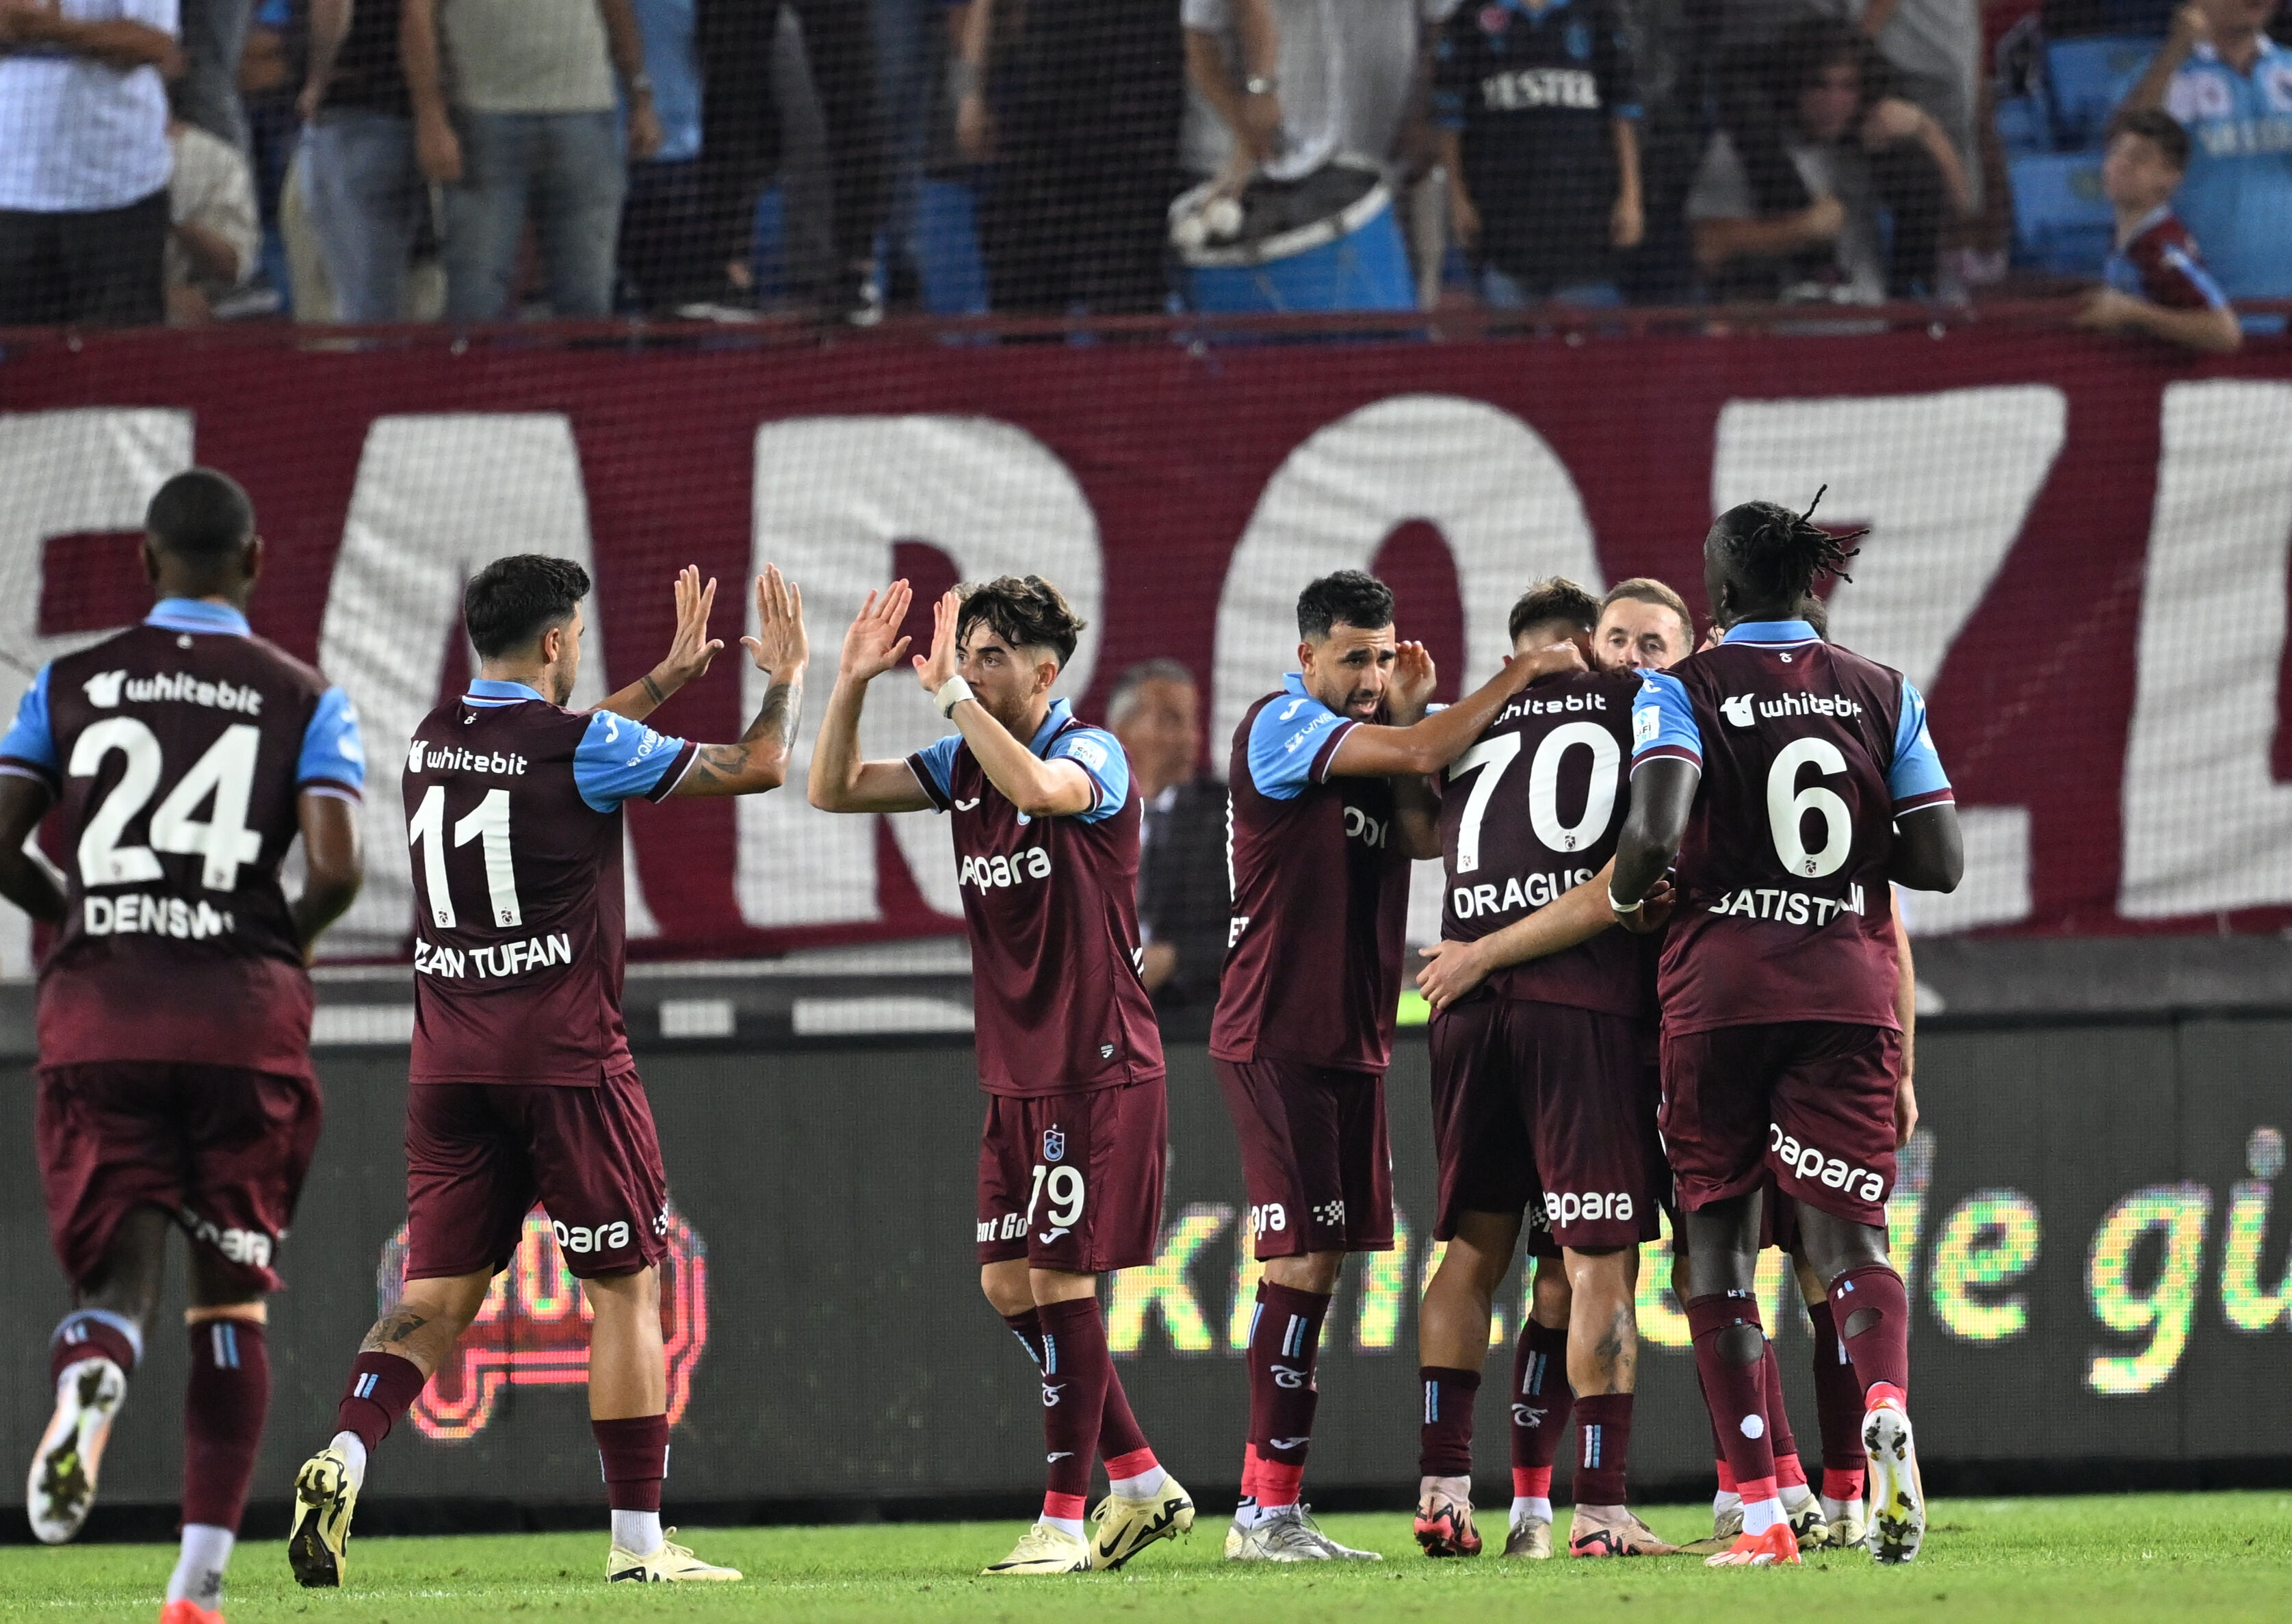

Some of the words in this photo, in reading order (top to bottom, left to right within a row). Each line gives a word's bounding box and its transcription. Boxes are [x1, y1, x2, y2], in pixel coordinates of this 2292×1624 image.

[125, 670, 264, 717] whitebit
[68, 716, 262, 891] 24
[426, 746, 528, 775] whitebit
[1448, 721, 1621, 874] 70
[1767, 737, 1852, 878] 6
[410, 785, 522, 929] 11
[469, 933, 571, 978] TUFAN
[1542, 1190, 1633, 1229] apara
